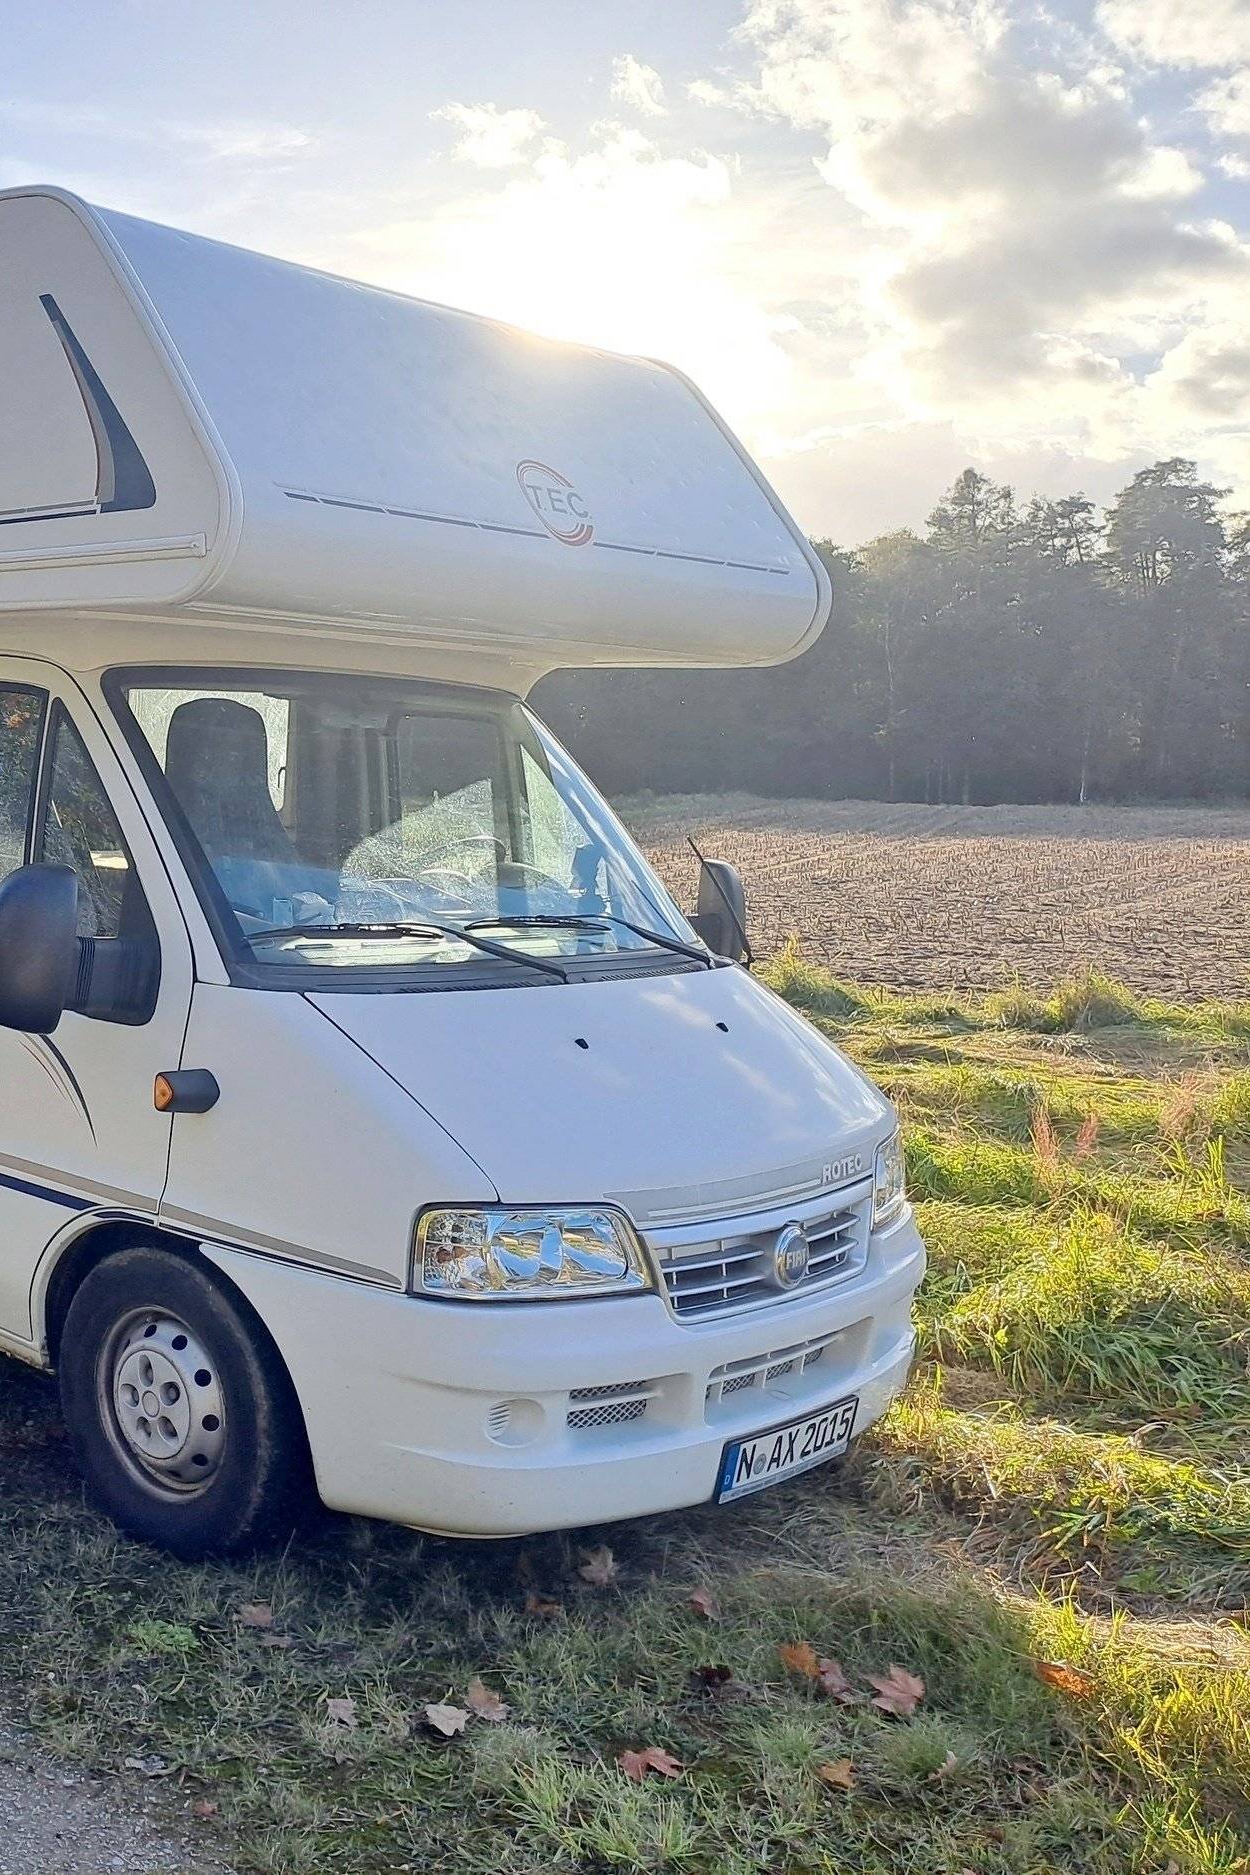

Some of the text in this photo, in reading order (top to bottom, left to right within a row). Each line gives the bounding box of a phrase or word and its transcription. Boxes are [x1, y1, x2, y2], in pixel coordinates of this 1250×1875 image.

[821, 1153, 862, 1185] ROTEC
[787, 1248, 809, 1269] FIAT
[736, 1444, 756, 1483] N
[766, 1428, 800, 1472] AX
[800, 1406, 853, 1456] 2015
[724, 1474, 731, 1485] D
